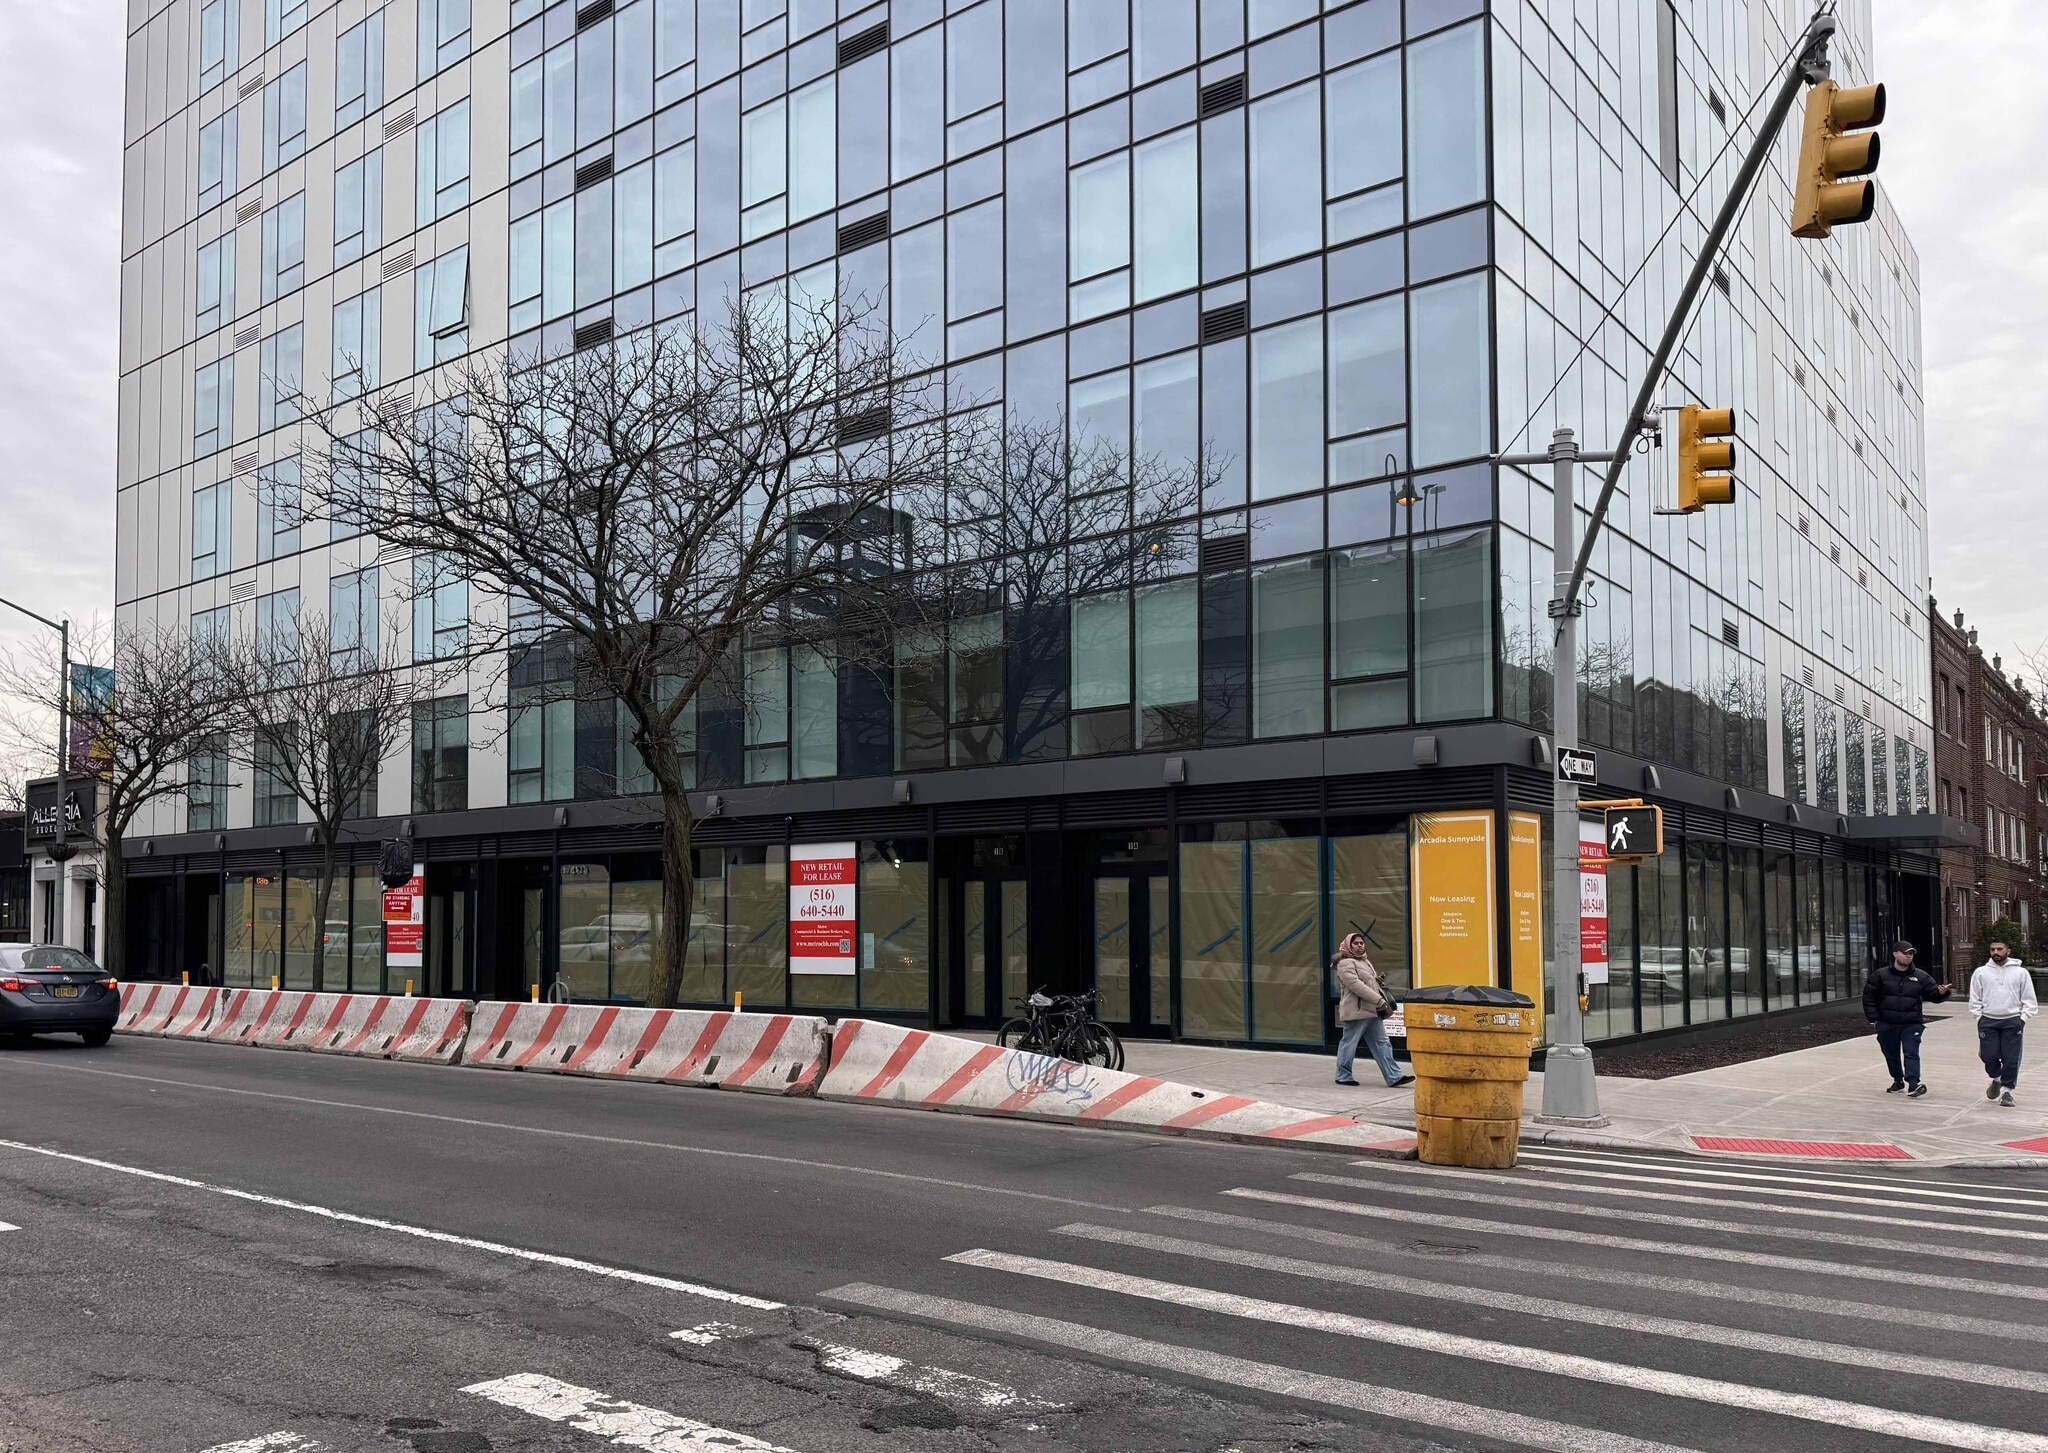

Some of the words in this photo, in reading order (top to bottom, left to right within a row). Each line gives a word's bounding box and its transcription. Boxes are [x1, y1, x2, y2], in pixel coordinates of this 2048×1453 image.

[1565, 758, 1576, 772] ONE
[1581, 760, 1592, 774] WAY
[31, 804, 81, 824] ALLERIA
[1419, 836, 1446, 844] Arcadia
[1447, 835, 1486, 844] Sunnyside
[801, 863, 816, 872] NEW
[818, 863, 844, 871] RETAIL
[803, 873, 818, 881] FOR
[819, 872, 842, 881] LEASE
[810, 889, 835, 903] (516)
[1447, 895, 1475, 903] Leasing
[800, 904, 845, 917] 640-5440
